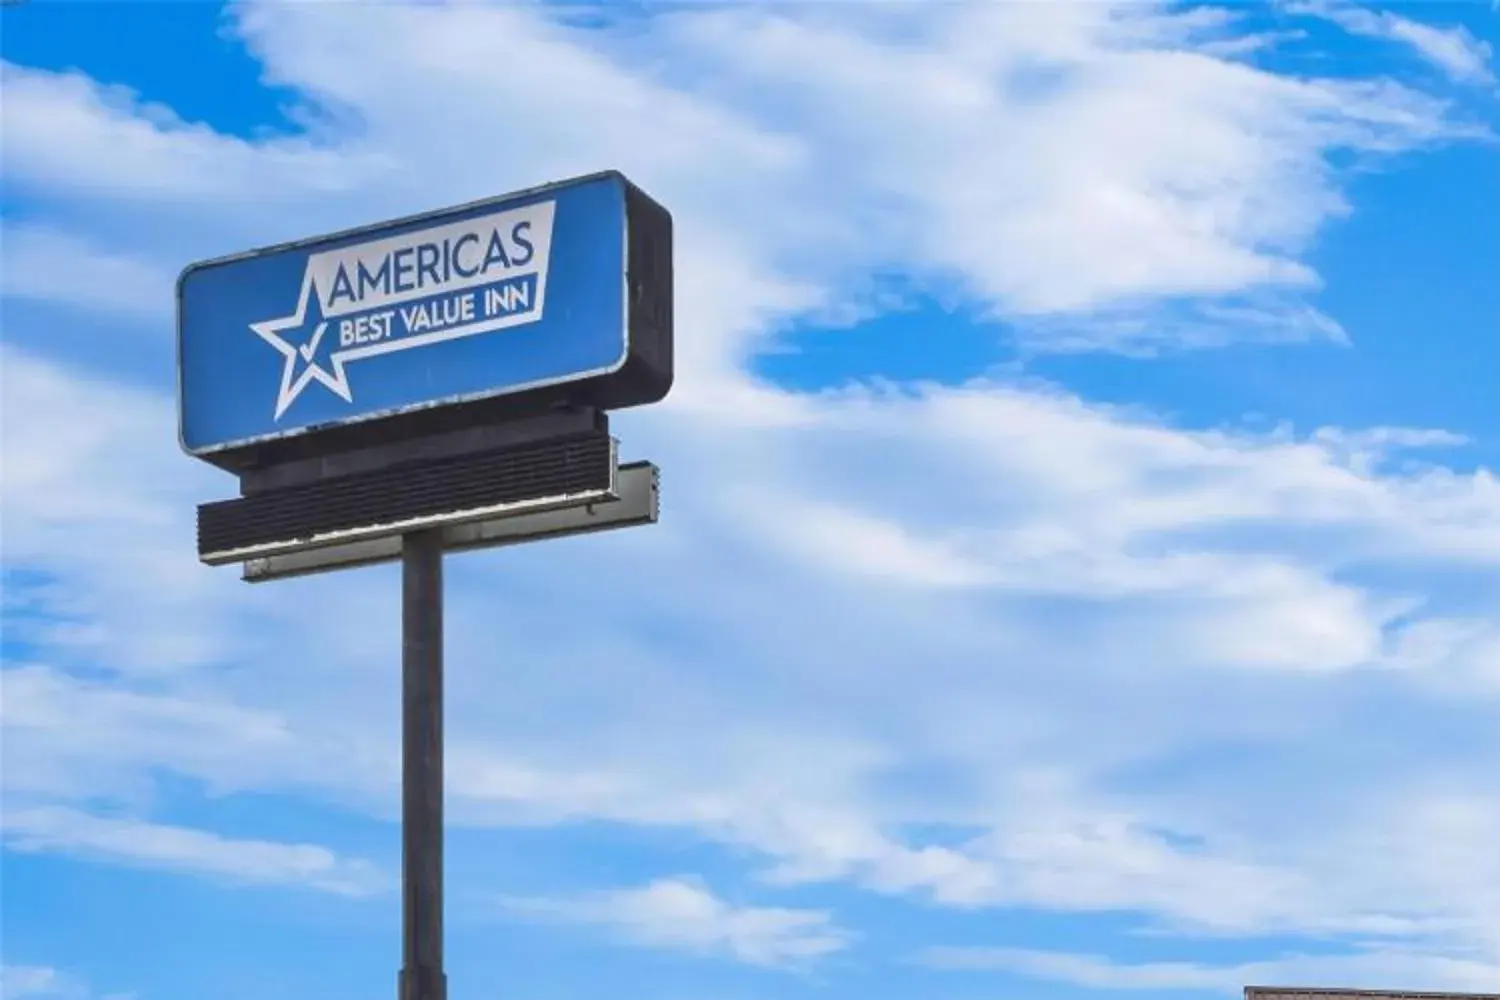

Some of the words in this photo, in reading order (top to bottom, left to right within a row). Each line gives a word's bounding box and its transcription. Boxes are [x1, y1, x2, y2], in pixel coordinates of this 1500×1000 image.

[328, 221, 534, 308] AMERICAS
[340, 311, 394, 346] BEST
[401, 294, 474, 332] VALUE
[485, 282, 528, 315] INN
